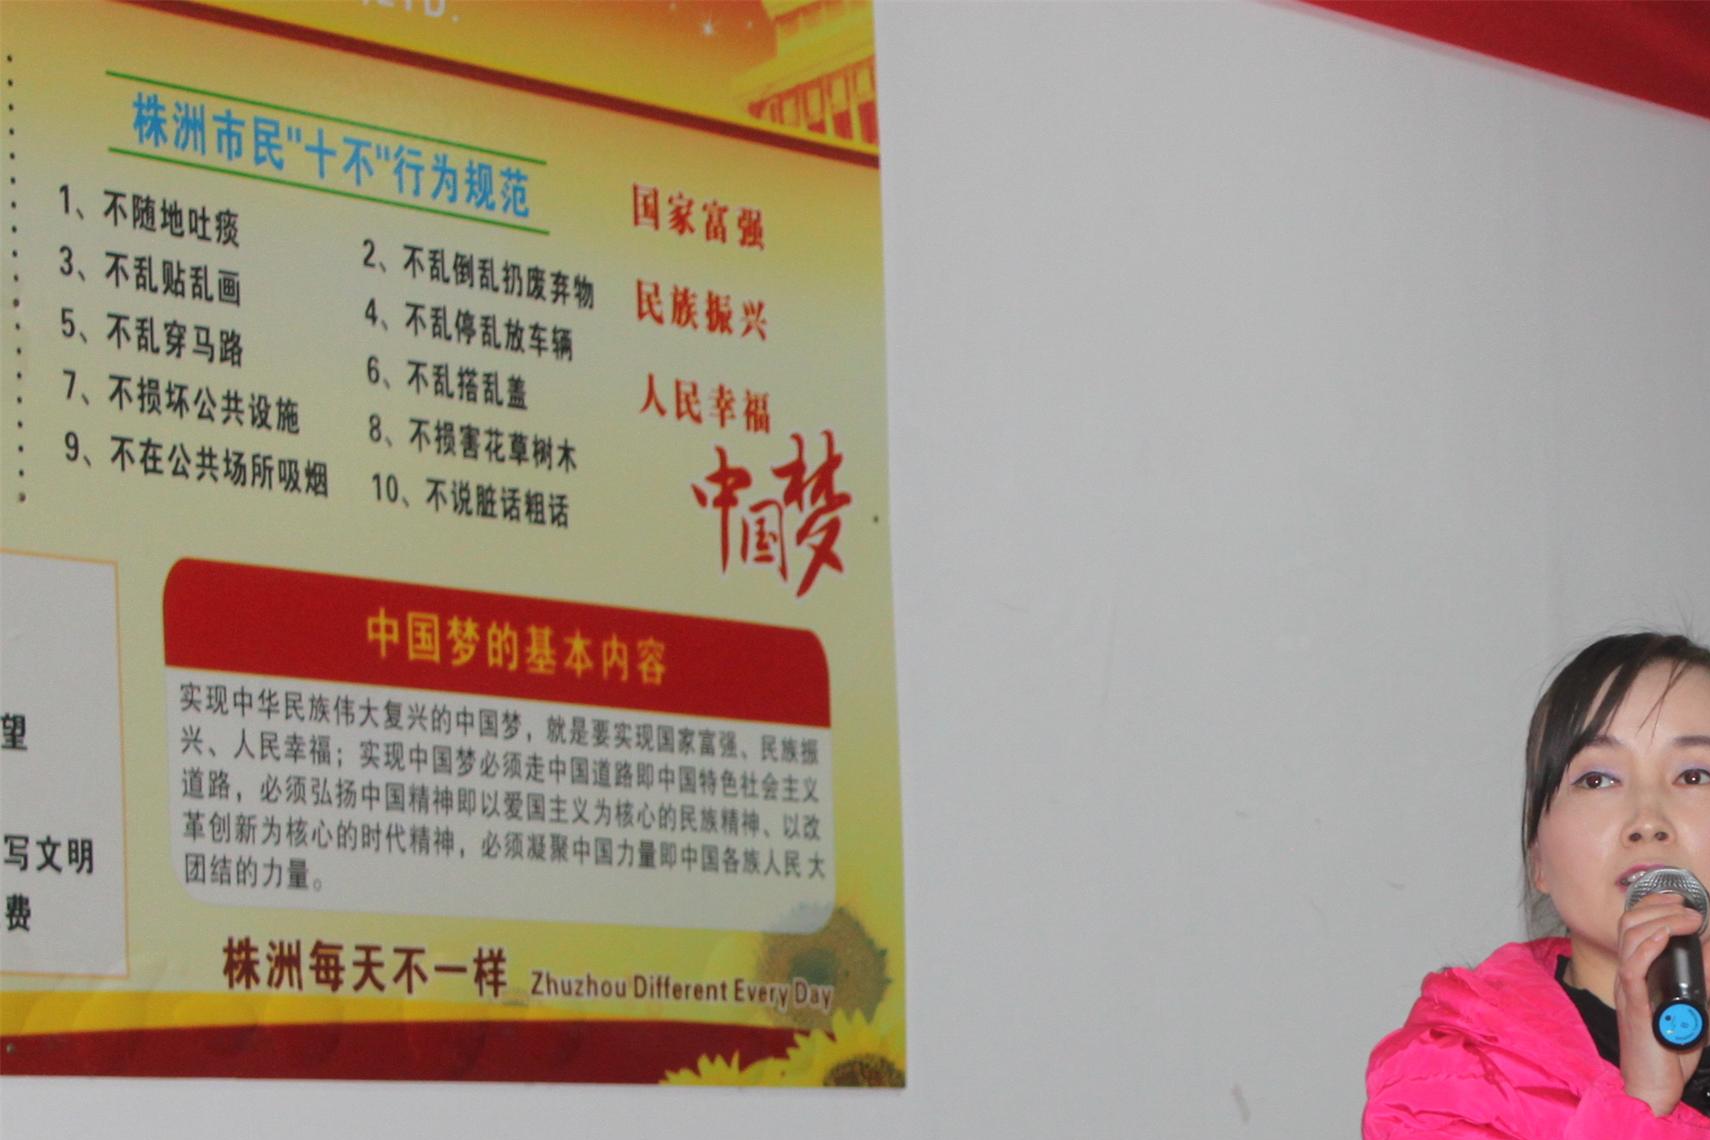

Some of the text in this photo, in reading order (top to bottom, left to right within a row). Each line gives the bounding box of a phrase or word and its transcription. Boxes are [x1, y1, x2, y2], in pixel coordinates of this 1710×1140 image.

[632, 183, 766, 250] 国家富强
[636, 278, 769, 341] 民族振兴
[639, 372, 772, 434] 人民幸福
[691, 430, 854, 597] 中国梦
[366, 607, 667, 687] 中国梦的基本内容
[0, 713, 28, 751] 望
[3, 835, 94, 874] 写文明
[5, 893, 31, 931] 费
[222, 936, 508, 999] 株洲每天不一样
[531, 970, 833, 1009] Zhuzhou Different Every Day
